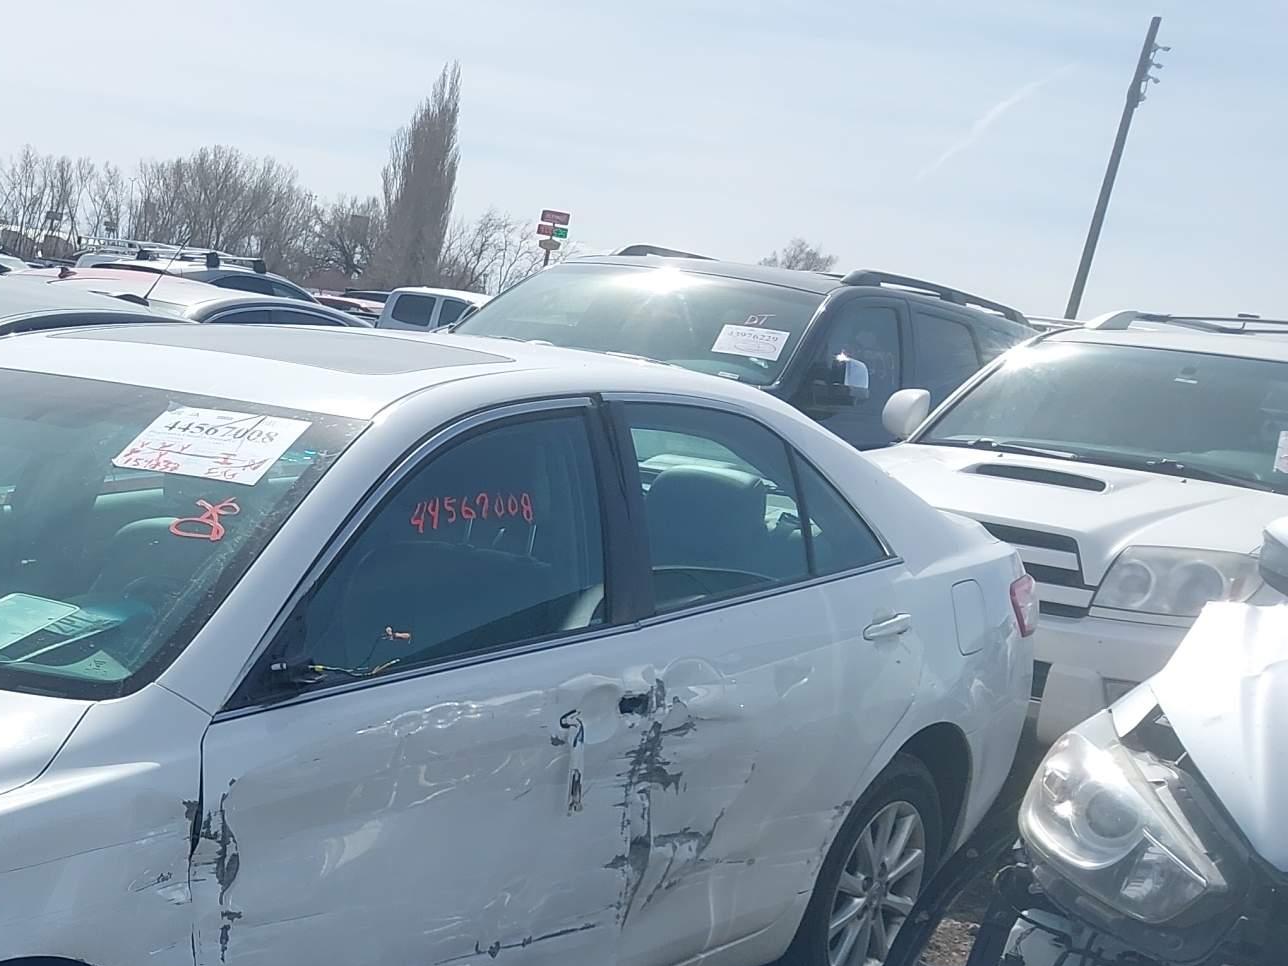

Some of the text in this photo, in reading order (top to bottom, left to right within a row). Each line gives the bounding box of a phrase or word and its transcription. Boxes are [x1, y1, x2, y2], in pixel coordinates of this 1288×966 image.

[743, 313, 776, 326] DT
[165, 420, 280, 444] 44567008
[410, 492, 534, 534] 44567008
